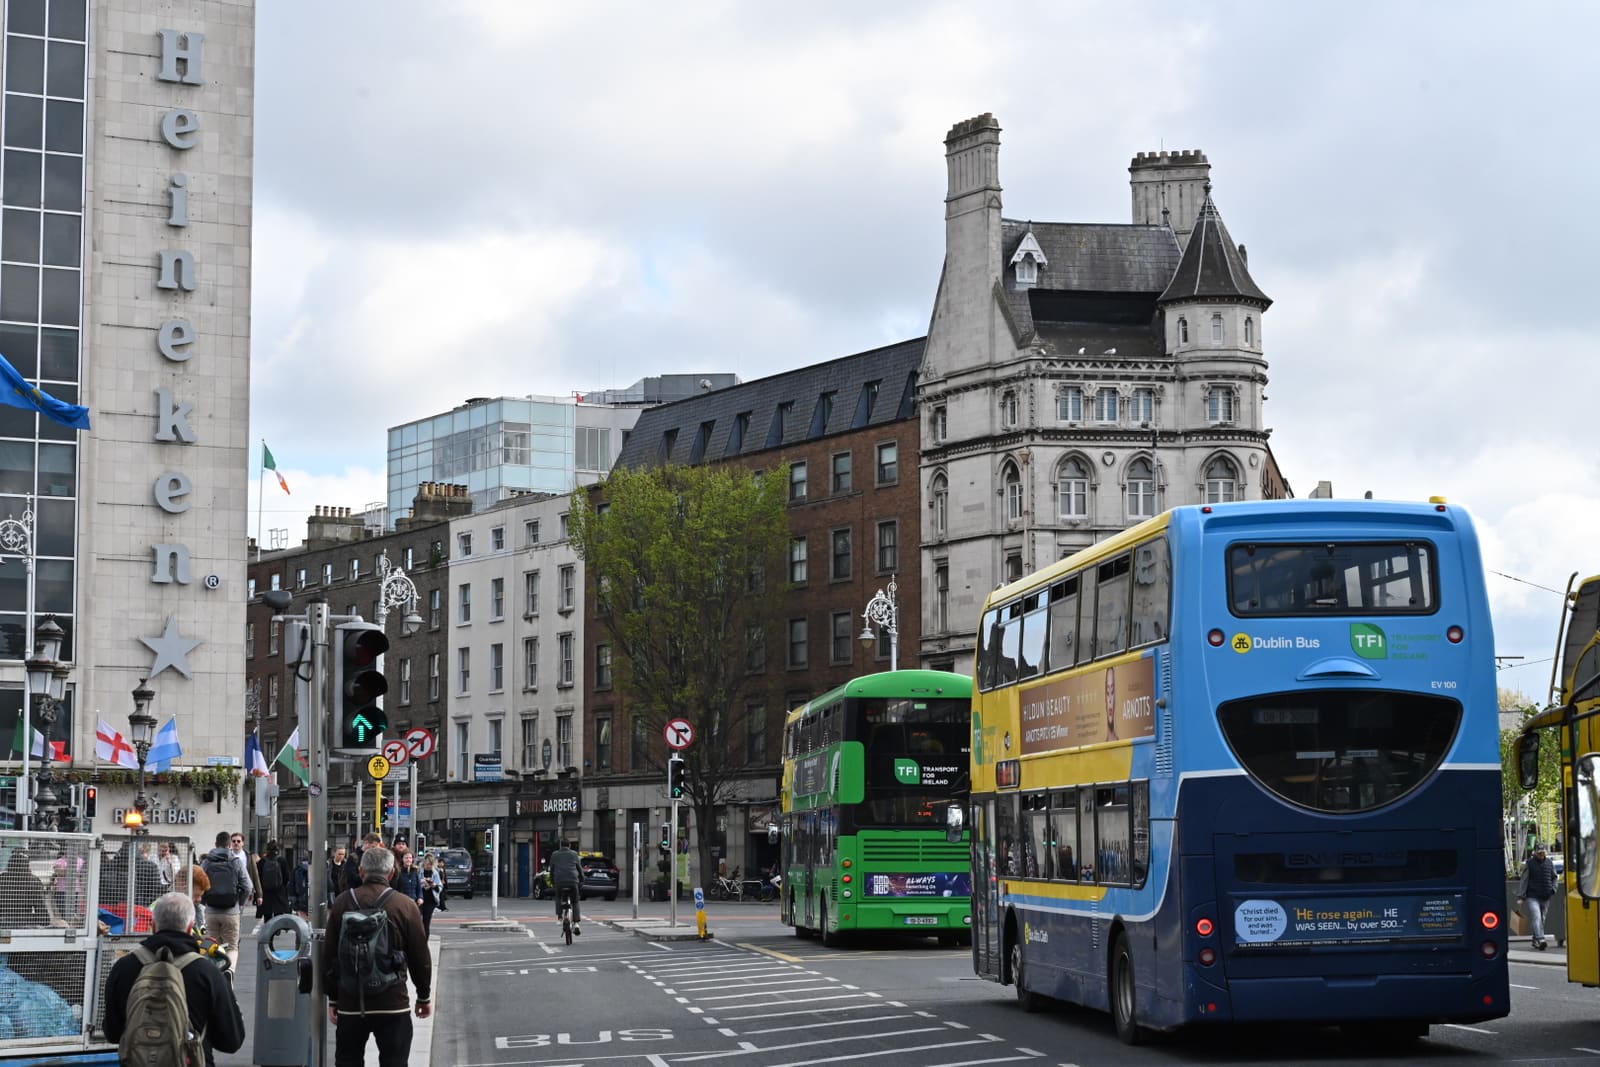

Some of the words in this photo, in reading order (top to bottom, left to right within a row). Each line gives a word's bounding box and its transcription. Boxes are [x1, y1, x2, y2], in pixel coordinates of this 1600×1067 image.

[151, 28, 205, 585] Heineken
[1253, 636, 1292, 649] Dublin
[1296, 637, 1320, 649] Bus
[1355, 634, 1383, 648] TFI
[1431, 681, 1442, 689] EV
[1443, 681, 1457, 689] 100
[1046, 695, 1071, 716] BEAUTY
[1122, 695, 1151, 720] ARNOTTS
[898, 766, 917, 776] TFI
[543, 799, 572, 812] BARBER
[168, 808, 198, 824] BAR
[906, 875, 936, 884] ALWAYS
[1316, 911, 1341, 919] rose
[1383, 908, 1398, 918] HE
[1295, 923, 1316, 931] WAS
[1360, 921, 1379, 929] over
[494, 1028, 674, 1049] BUS
